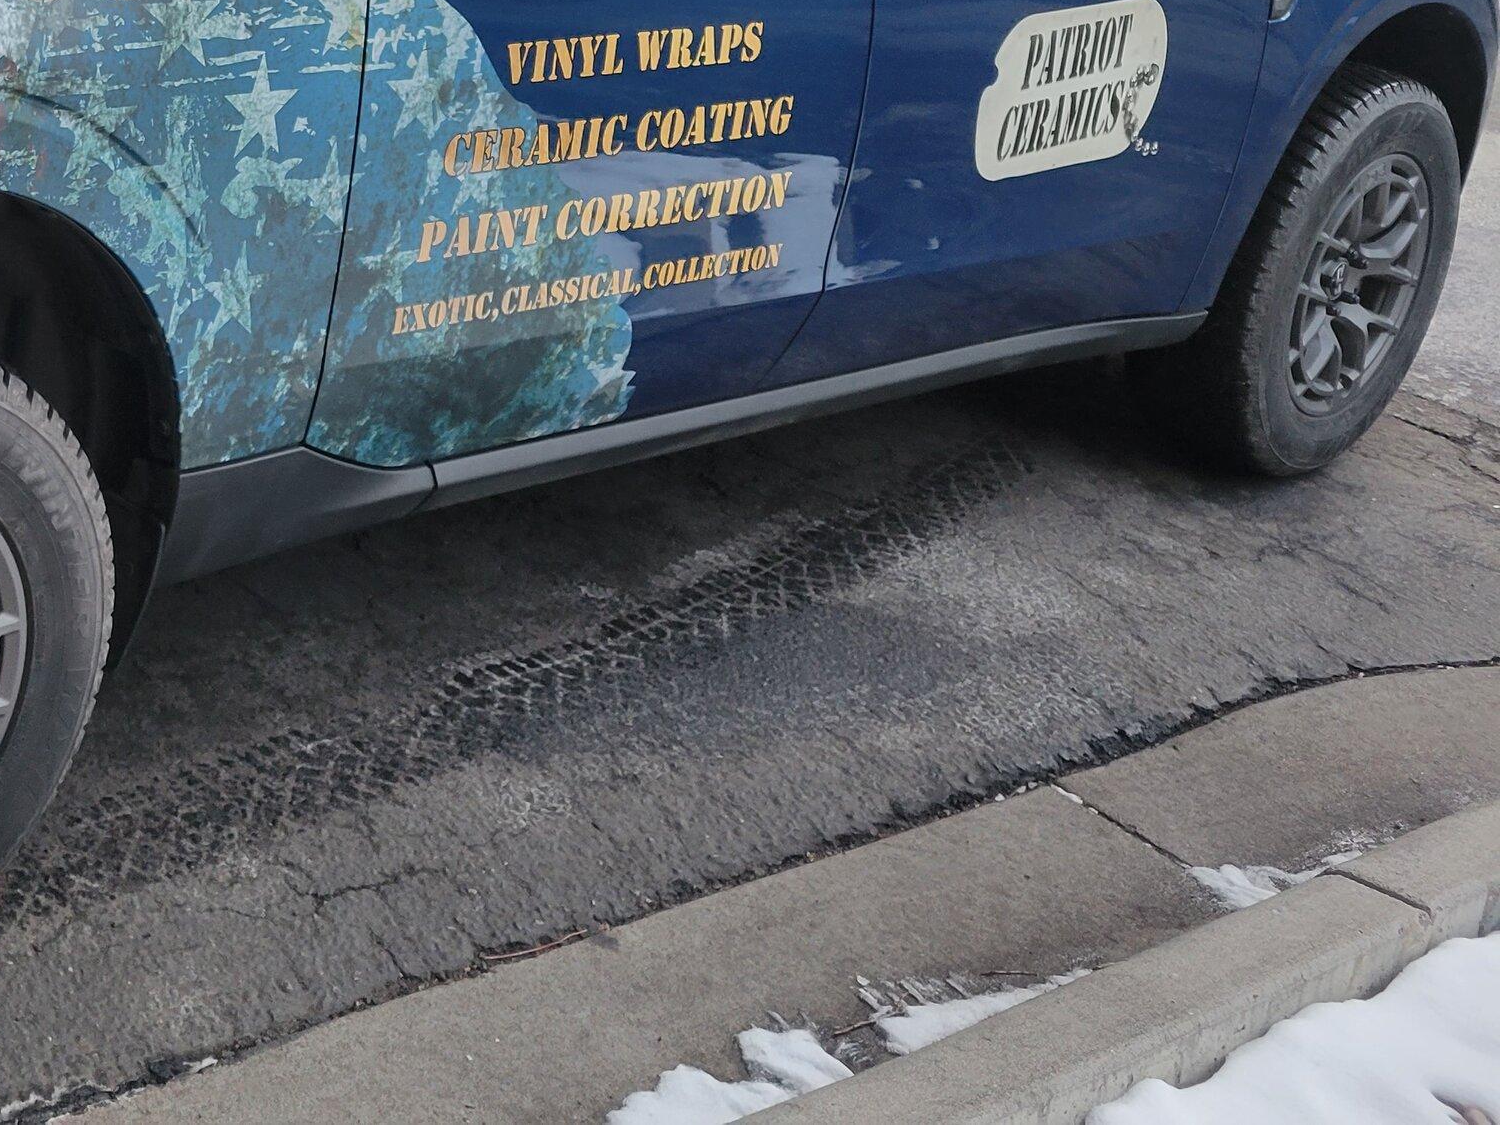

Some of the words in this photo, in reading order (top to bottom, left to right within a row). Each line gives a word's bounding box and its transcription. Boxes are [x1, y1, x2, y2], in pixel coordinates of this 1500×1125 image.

[507, 33, 623, 85] VINYL
[637, 21, 764, 72] WRAPS
[1020, 13, 1134, 91] PATRIOT
[443, 113, 629, 178] CERAMIC
[636, 94, 795, 152] COATING
[996, 80, 1127, 163] CERAMICS
[416, 204, 549, 264] PAINT
[555, 171, 793, 241] CORRECTION
